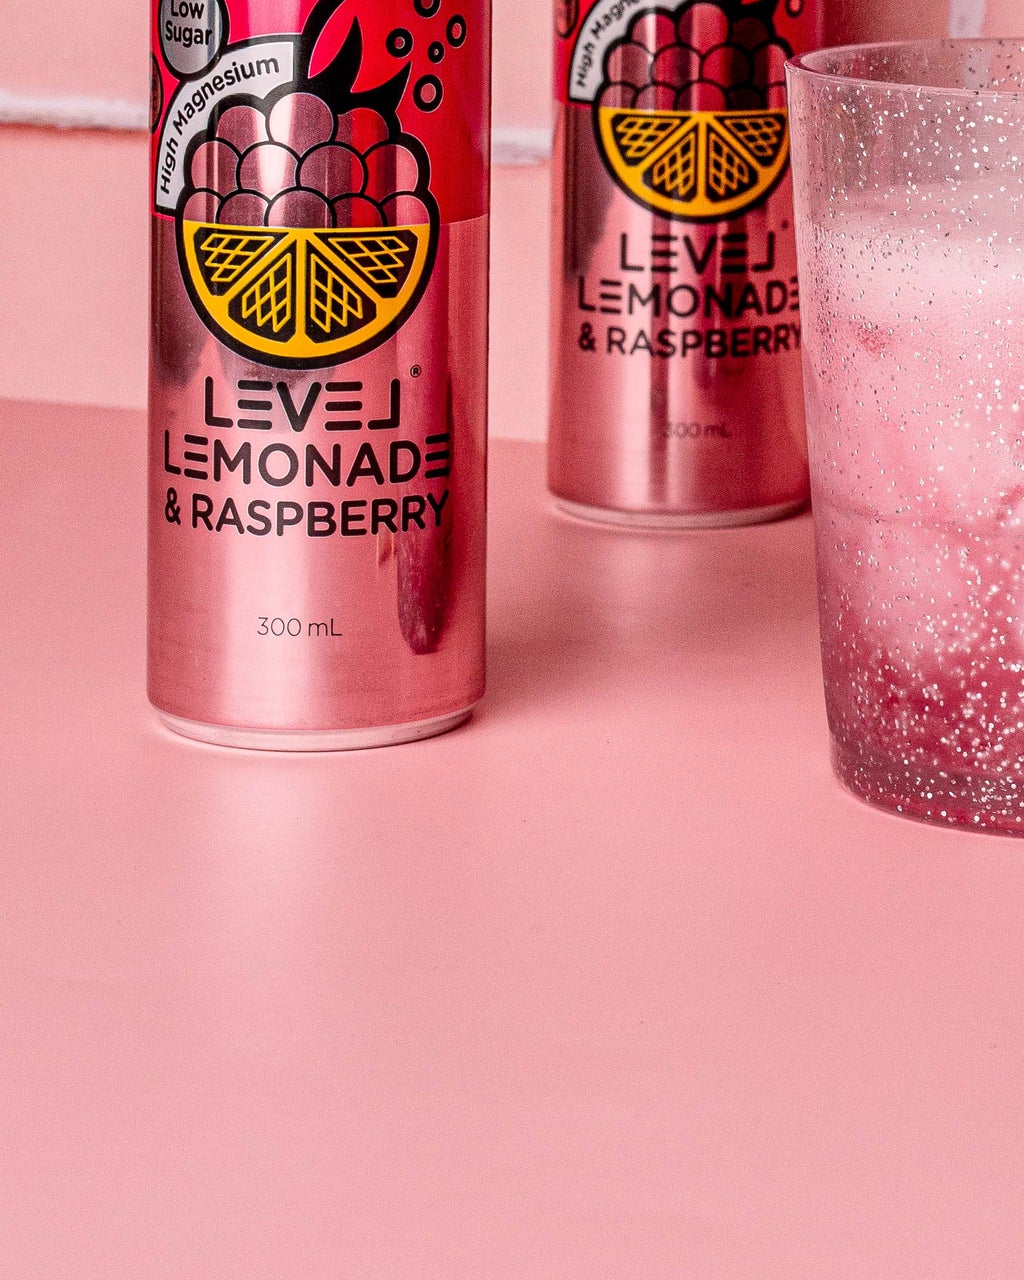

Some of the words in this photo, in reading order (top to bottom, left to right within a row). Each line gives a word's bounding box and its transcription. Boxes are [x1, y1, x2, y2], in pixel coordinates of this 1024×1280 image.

[165, 21, 213, 48] Sugar
[576, 42, 594, 87] High
[161, 134, 178, 194] High
[173, 56, 280, 136] Magnesium
[620, 232, 775, 275] LEVEL
[578, 321, 595, 352] &
[204, 375, 400, 432] LEVEL
[164, 428, 450, 487] LEMONADE
[164, 486, 181, 525] &
[191, 489, 449, 537] RASPBERRY
[256, 616, 301, 637] 300
[307, 617, 343, 637] mL
